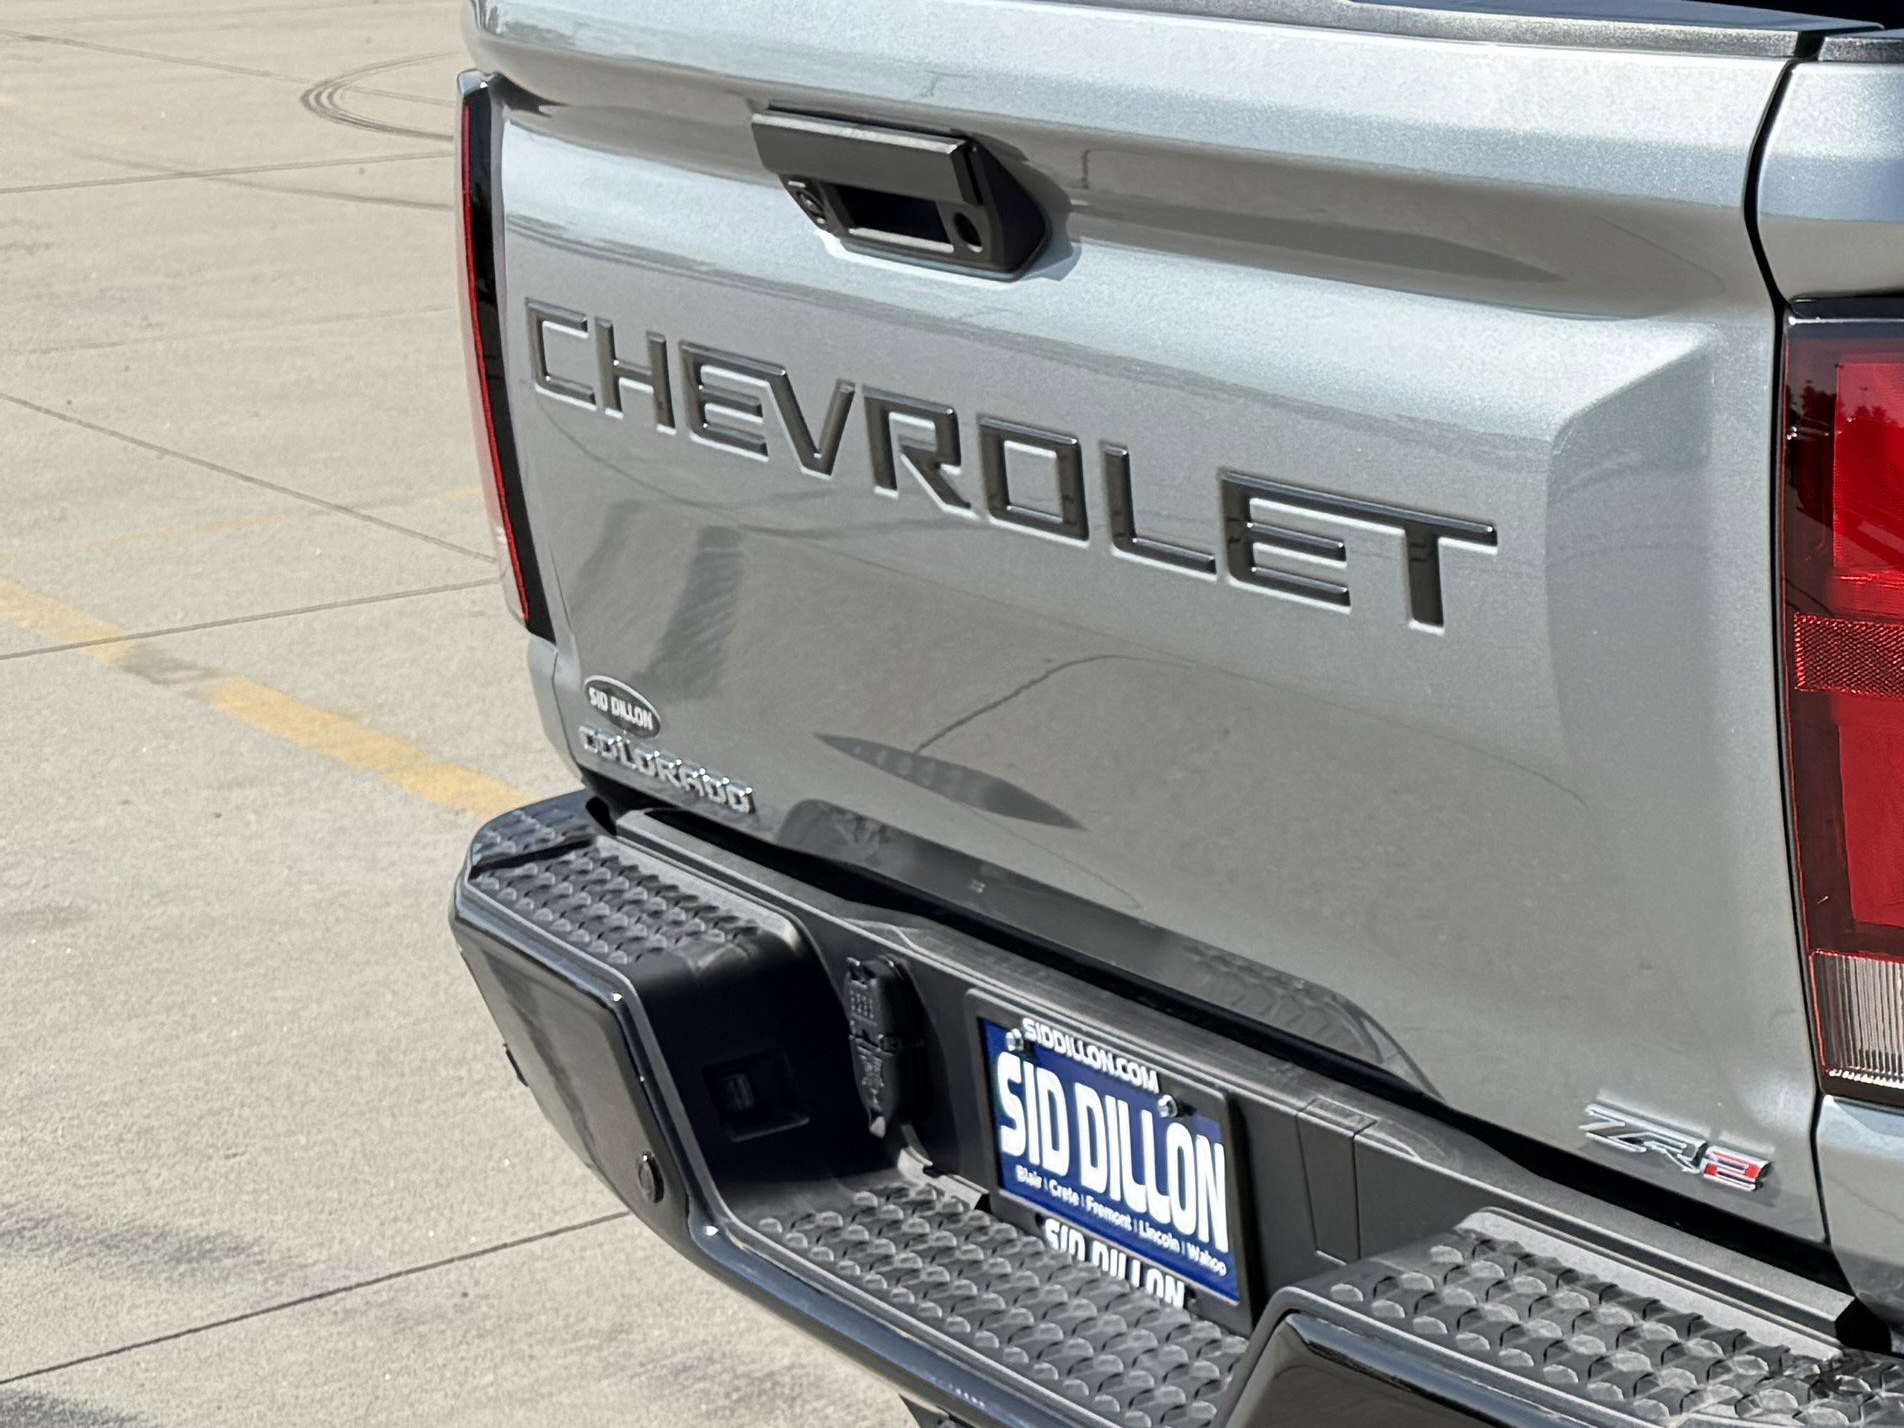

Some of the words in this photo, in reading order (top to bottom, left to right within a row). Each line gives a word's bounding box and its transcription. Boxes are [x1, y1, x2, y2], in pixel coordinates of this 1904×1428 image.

[524, 298, 1499, 634] CHEVROLET
[588, 686, 608, 712] SID
[610, 696, 654, 730] DILLON
[578, 724, 756, 813] COLORADO
[1022, 1018, 1159, 1093] SIDDILLON.COM
[997, 1051, 1070, 1177] SID
[1074, 1082, 1229, 1254] DILLON
[1578, 1104, 1772, 1192] ZR2
[1086, 1195, 1132, 1232] Fremont
[1139, 1220, 1180, 1254] Lincoln
